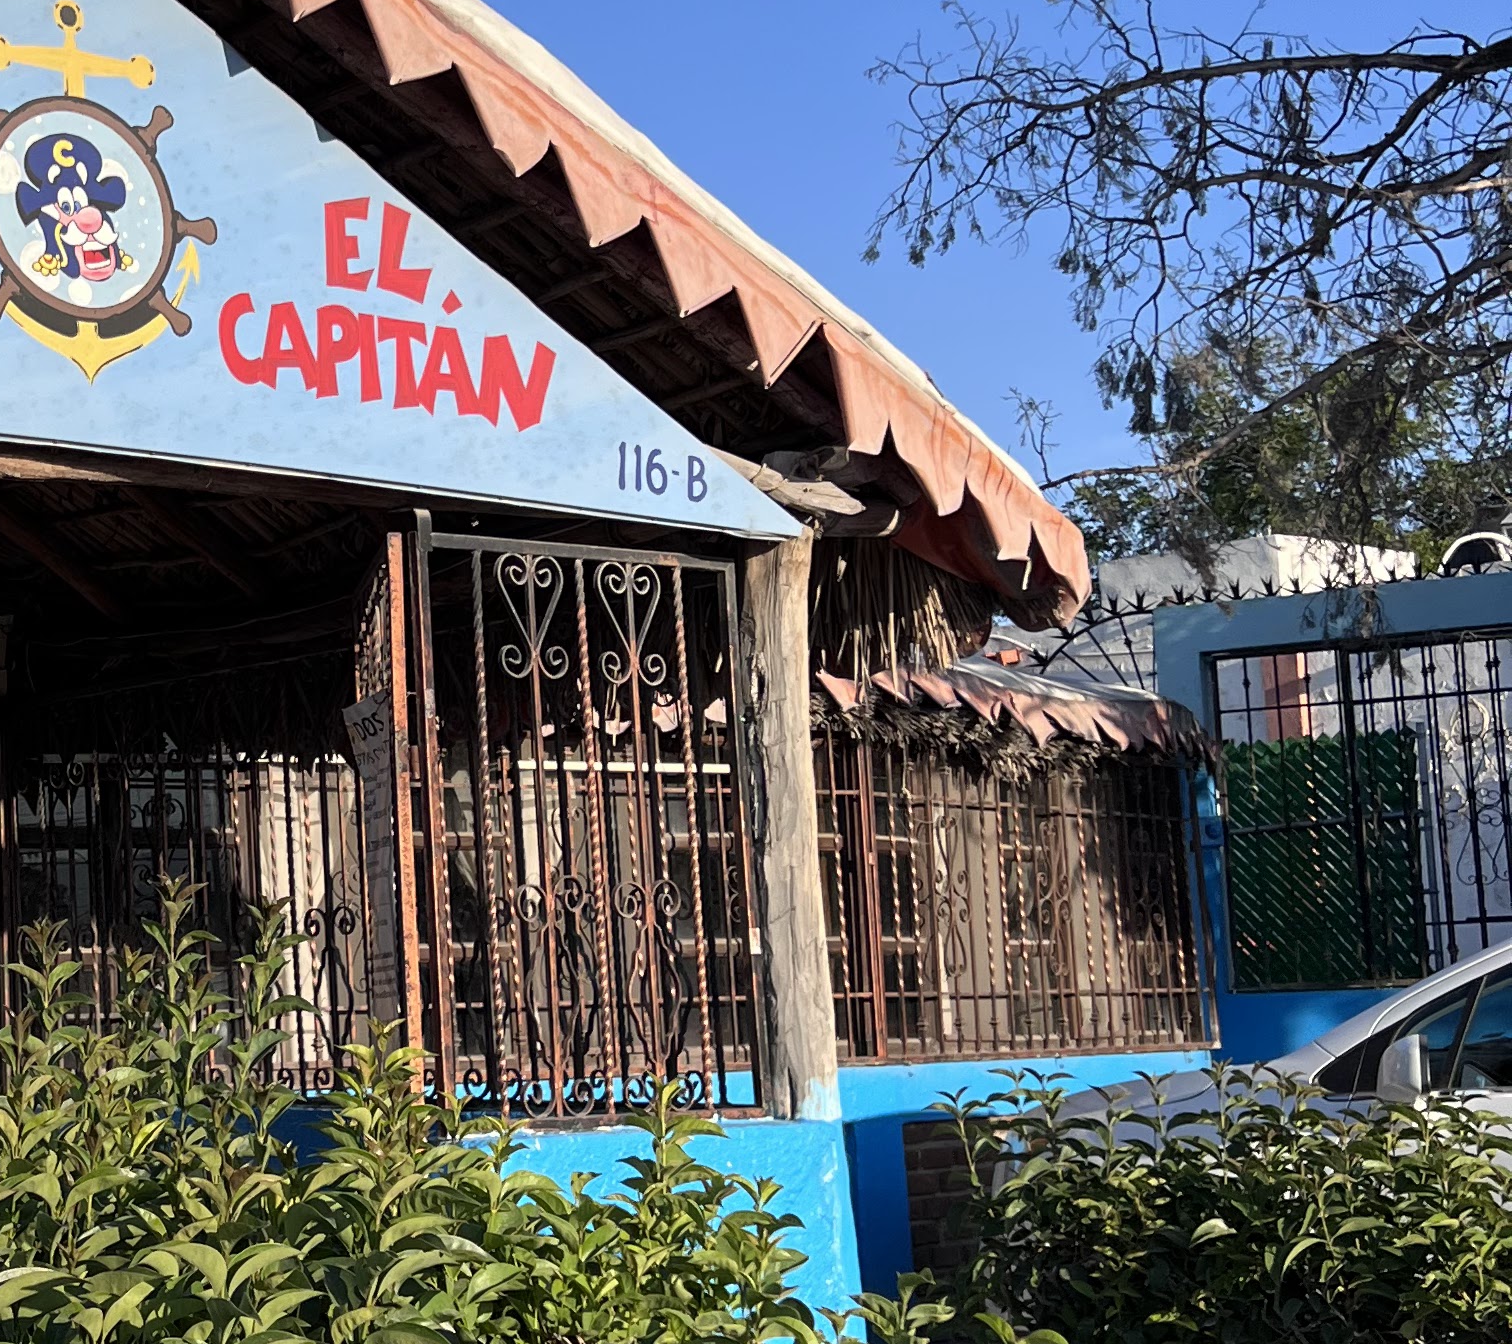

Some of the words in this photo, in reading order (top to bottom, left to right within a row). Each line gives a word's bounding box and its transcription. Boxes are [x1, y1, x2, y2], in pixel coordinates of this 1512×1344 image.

[324, 196, 433, 305] EL
[218, 289, 557, 433] CAPITÁN
[618, 441, 708, 503] 116-B
